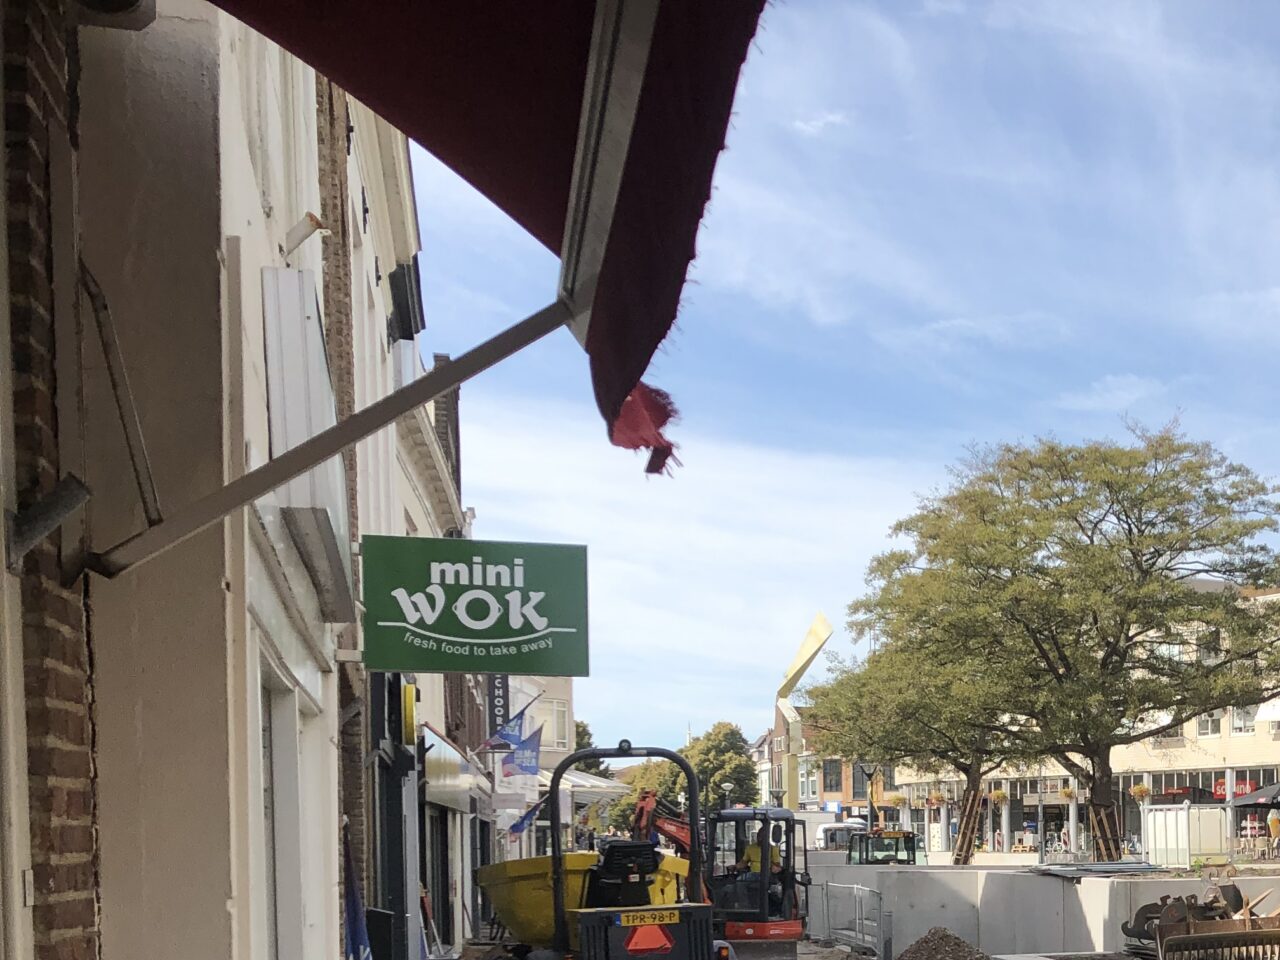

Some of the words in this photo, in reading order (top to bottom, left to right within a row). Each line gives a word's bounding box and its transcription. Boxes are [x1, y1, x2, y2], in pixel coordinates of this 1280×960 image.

[431, 556, 524, 587] mini
[403, 632, 438, 650] fresh
[441, 641, 470, 656] food
[473, 645, 487, 656] to
[489, 644, 518, 656] take
[520, 637, 553, 653] away
[625, 912, 676, 924] TPR-98-P
